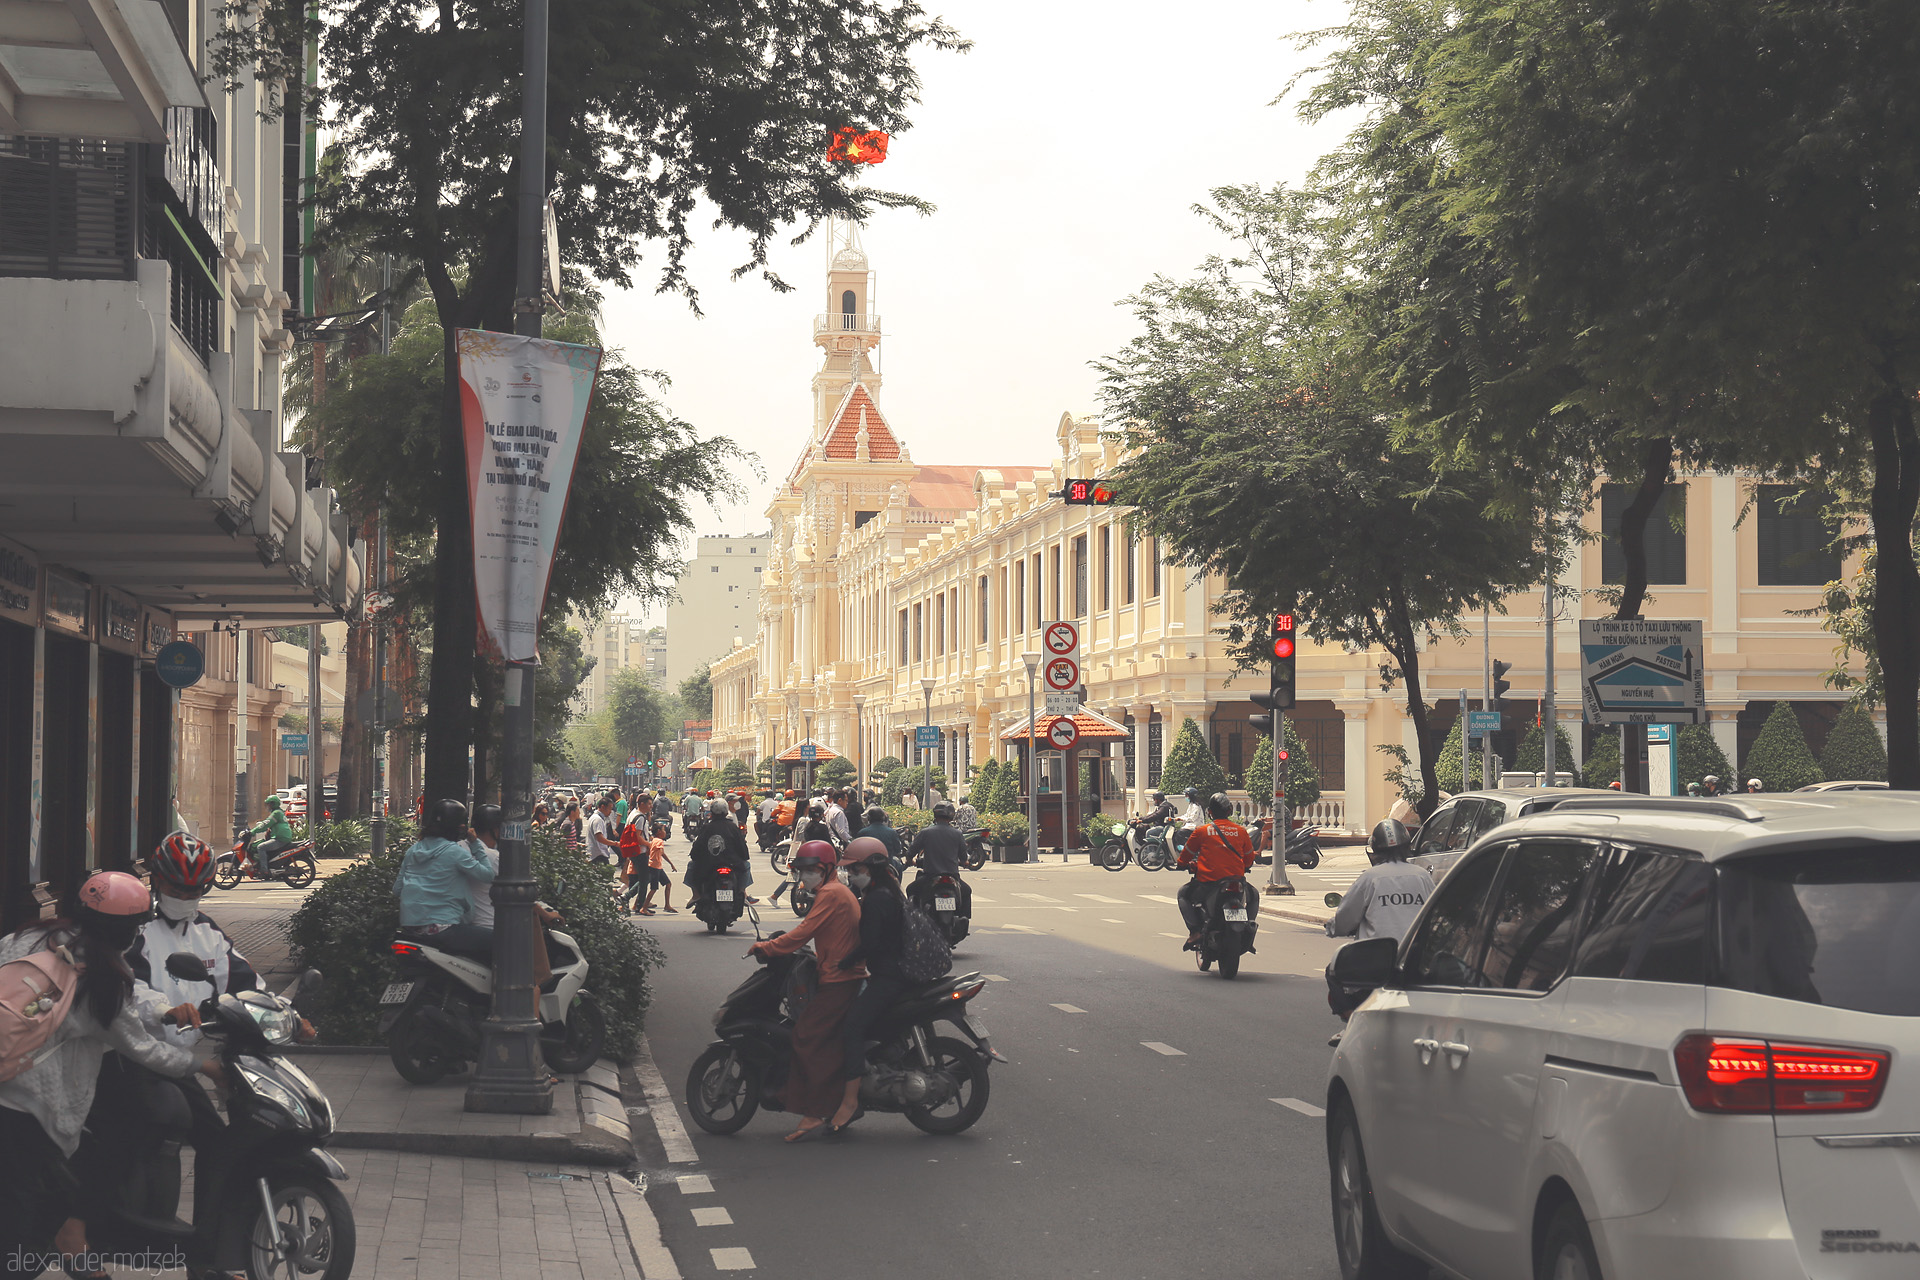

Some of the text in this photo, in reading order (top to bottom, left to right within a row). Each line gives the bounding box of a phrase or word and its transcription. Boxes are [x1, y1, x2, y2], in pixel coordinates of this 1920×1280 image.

[506, 426, 525, 437] GIAO
[1071, 483, 1086, 500] 30
[1276, 614, 1293, 631] 30
[1592, 623, 1601, 635] LỘ
[1602, 621, 1620, 632] TRÌNH
[1621, 622, 1629, 632] XE
[1644, 622, 1658, 632] TAXI
[1659, 622, 1671, 633] LƯU
[1672, 621, 1692, 632] THÔNG
[1602, 633, 1681, 645] TRÊN ĐƯỜNG LÊ THÁNH TÔN
[1599, 652, 1625, 670] HÀM NGHI
[1655, 655, 1682, 670] PASTEUR
[1621, 687, 1654, 699] NGUYỄN HUỆ
[1378, 893, 1425, 907] TODA
[1821, 1229, 1880, 1239] GRAND
[1819, 1240, 1920, 1253] SEDONA
